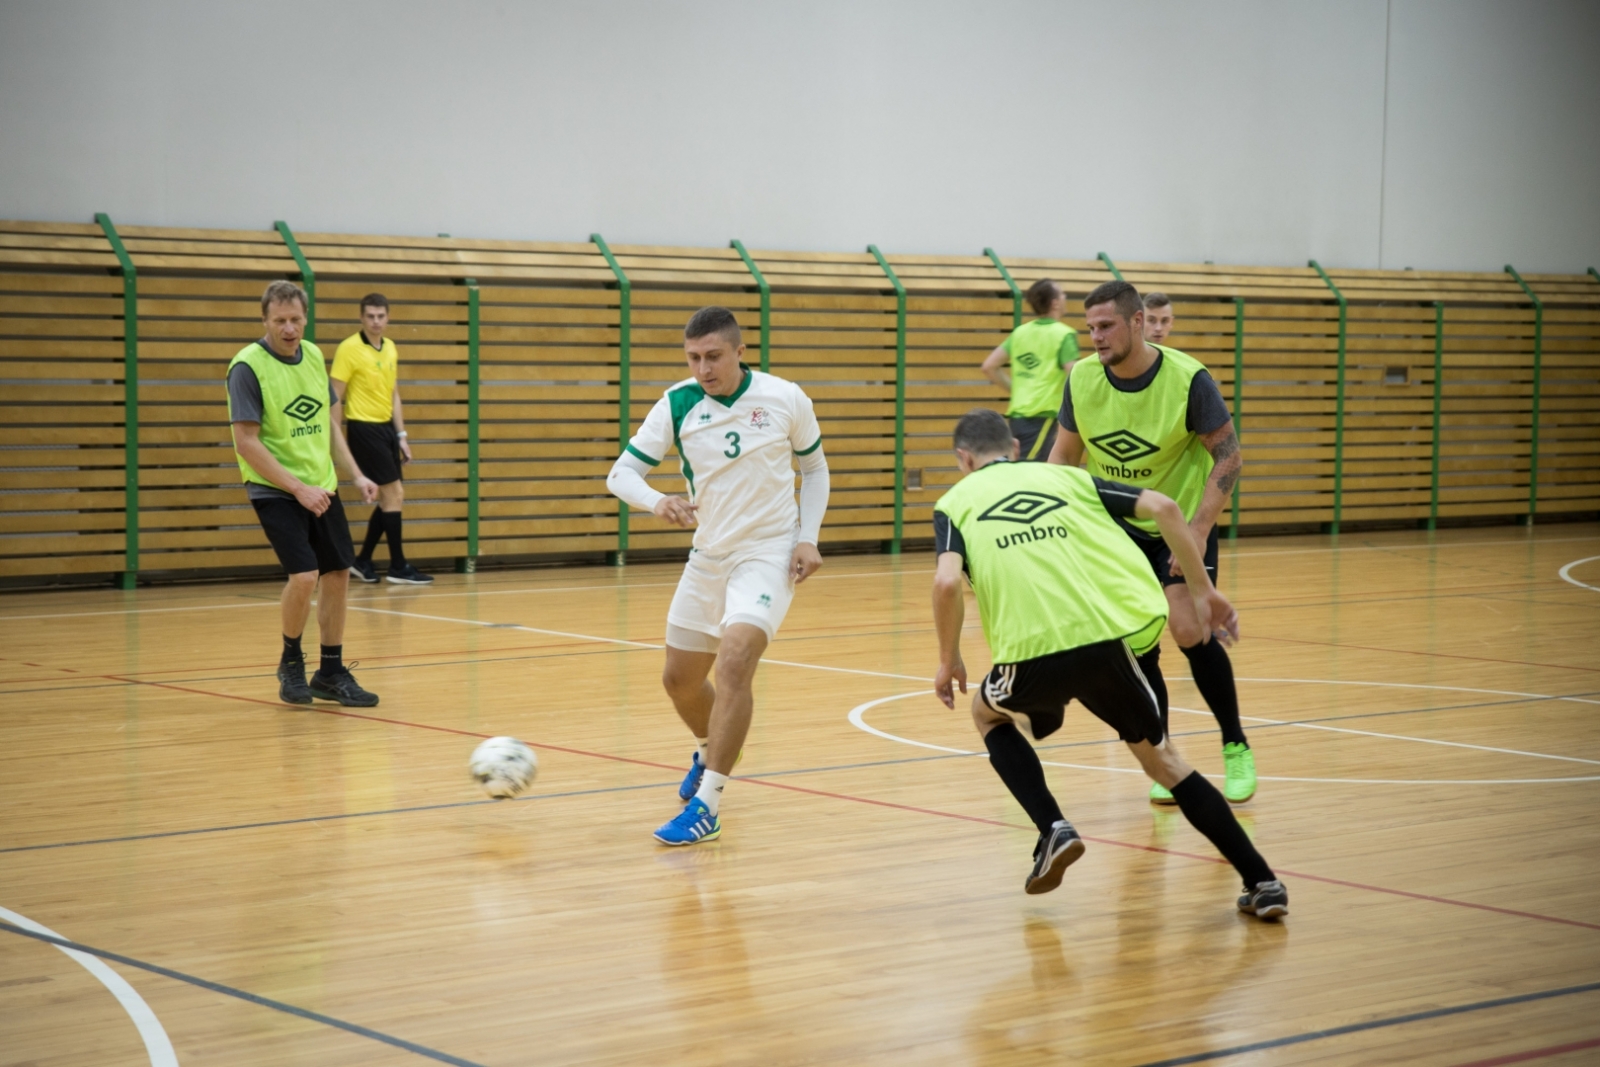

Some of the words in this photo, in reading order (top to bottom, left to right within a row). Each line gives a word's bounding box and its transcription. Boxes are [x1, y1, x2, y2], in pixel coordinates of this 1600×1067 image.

[290, 423, 322, 438] umbro
[724, 431, 742, 459] 3
[995, 525, 1067, 549] umbro
